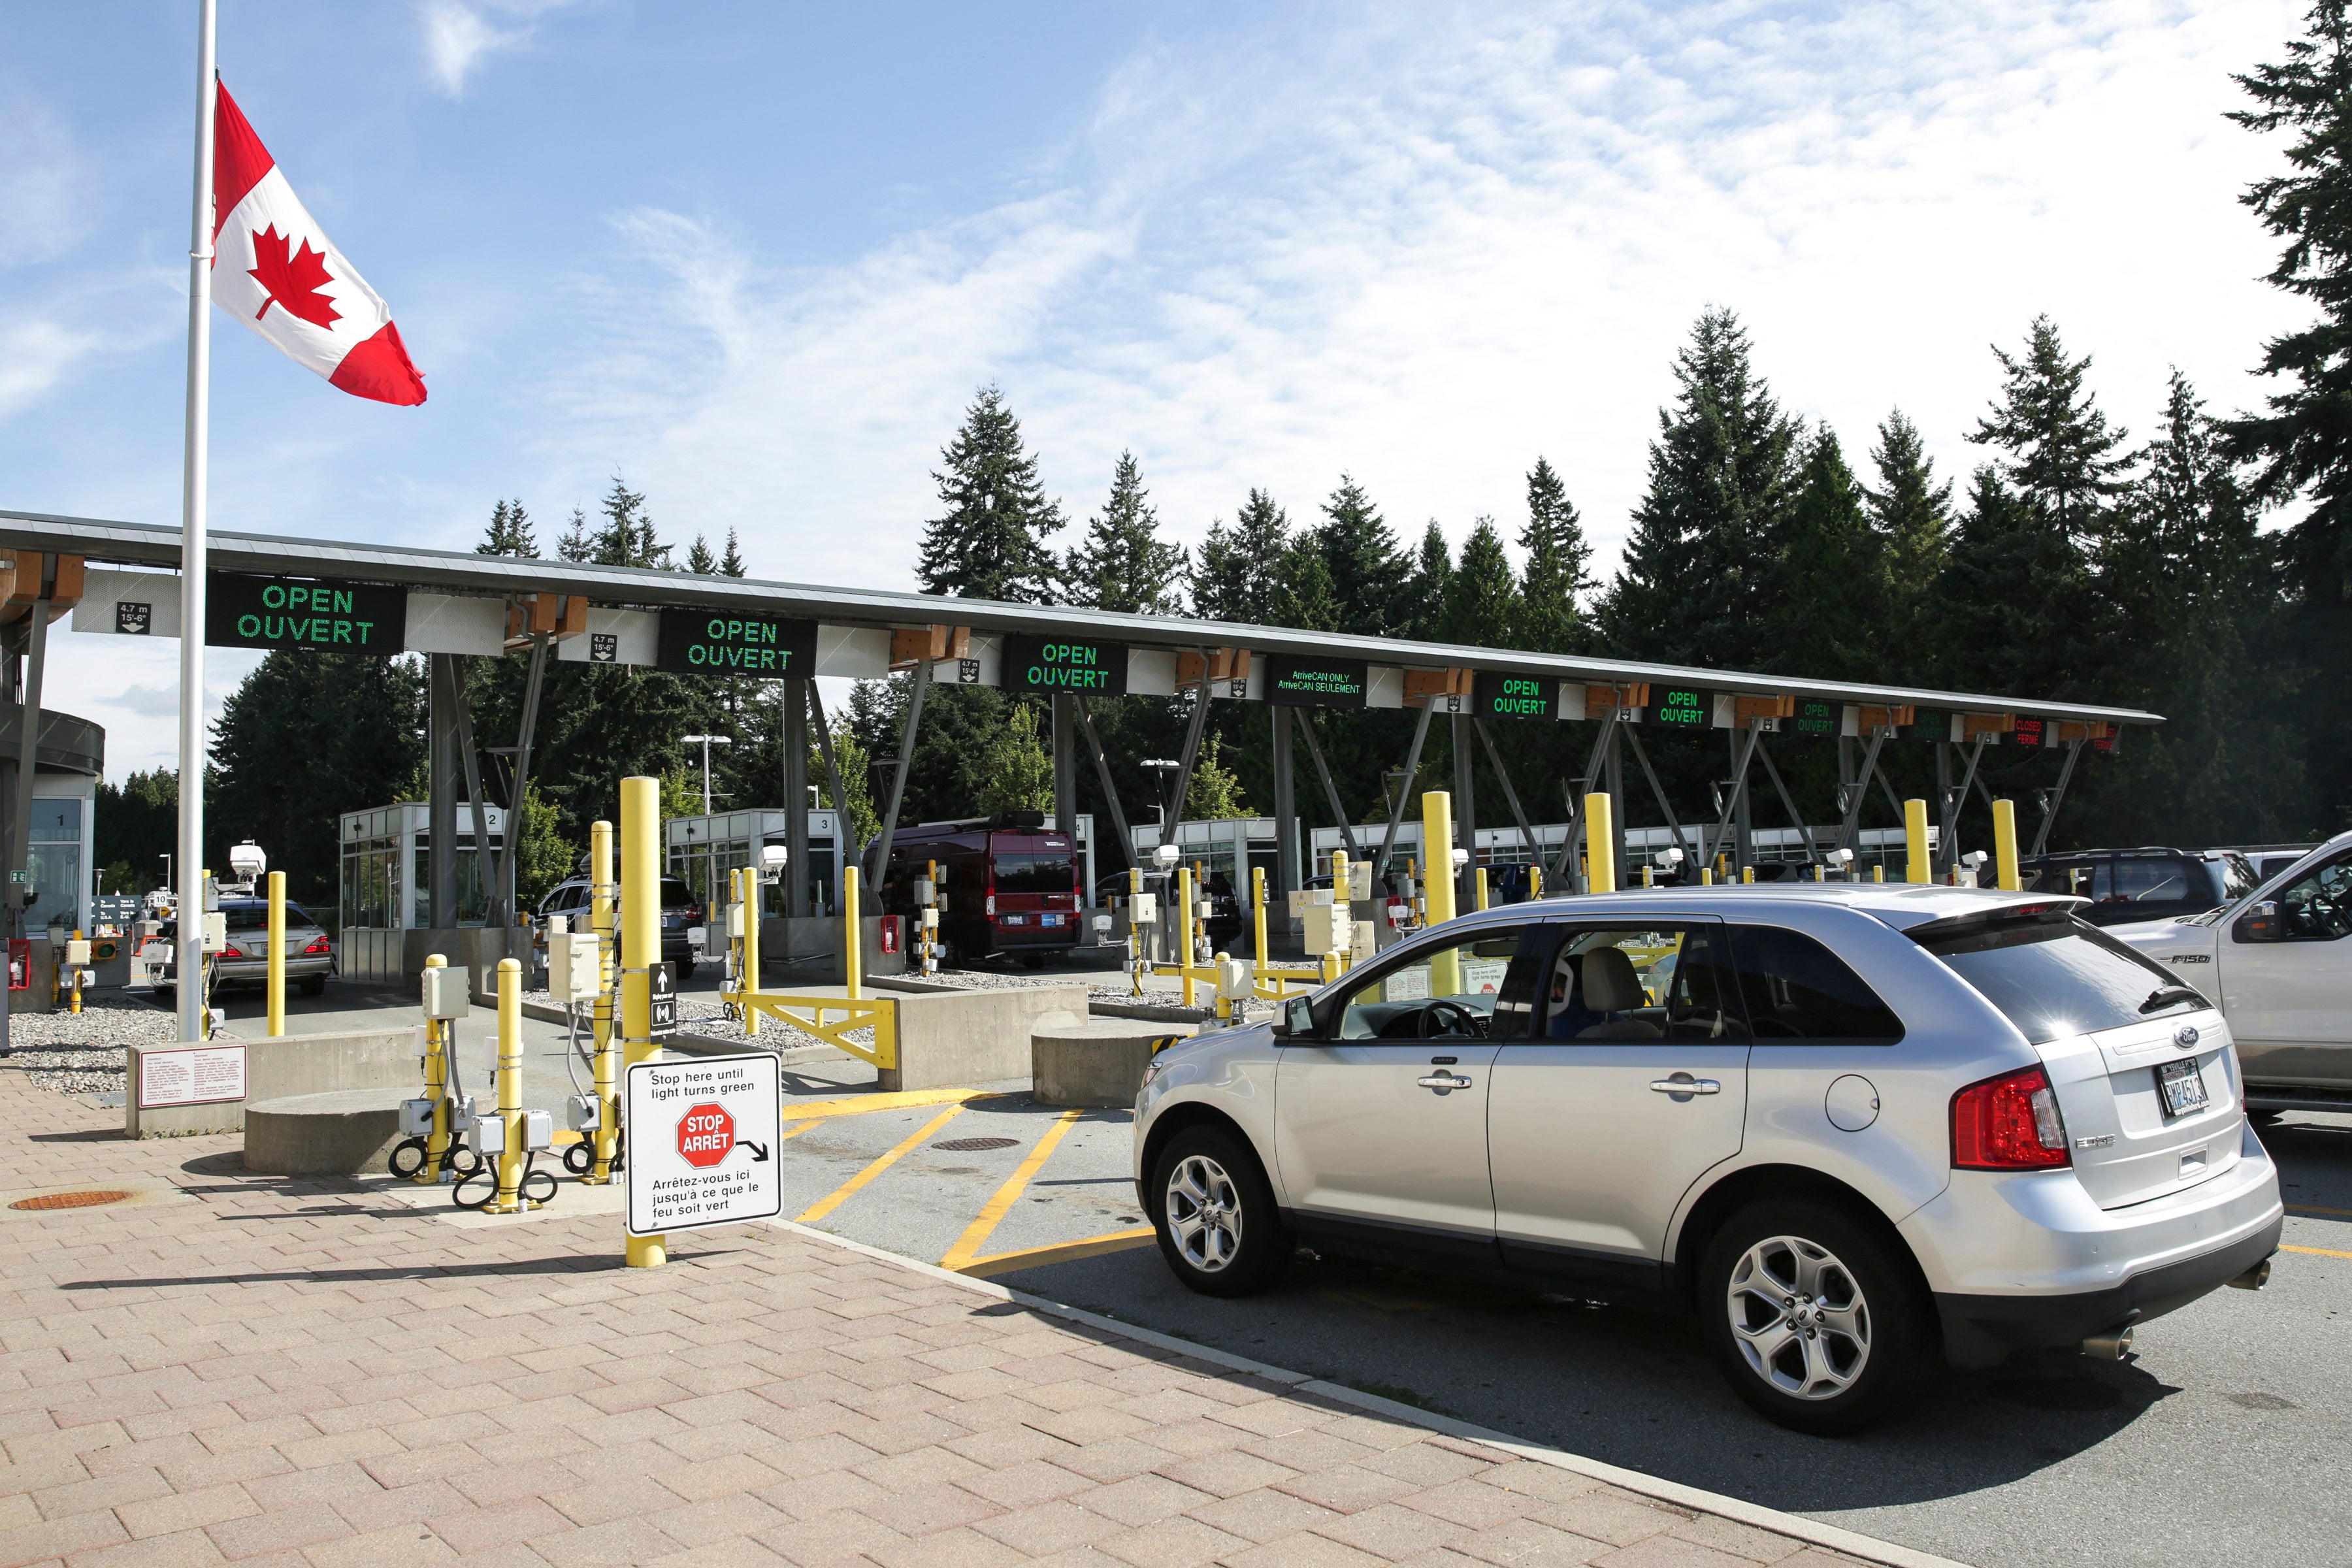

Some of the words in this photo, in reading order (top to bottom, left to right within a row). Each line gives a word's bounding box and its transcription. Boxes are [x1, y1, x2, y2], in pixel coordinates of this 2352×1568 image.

[263, 585, 353, 613] OPEN
[120, 604, 135, 613] 4.7
[121, 613, 146, 622] 15'-6"
[238, 614, 374, 645] OUVERT
[708, 619, 777, 644] OPEN
[688, 644, 792, 670] OUVERT
[1042, 644, 1096, 665] OPEN
[1028, 666, 1109, 689] OUVERT
[1292, 670, 1328, 681] ArriveCAN
[1329, 673, 1350, 683] ONLY
[1278, 679, 1314, 691] ArriveCAN
[1315, 682, 1360, 694] SEULEMENT
[1503, 679, 1539, 696] OPEN
[1494, 697, 1547, 715] OUVERT
[1668, 692, 1697, 706] OPEN
[1660, 708, 1704, 723] OUVERT
[1805, 704, 1829, 717] OPEN
[1798, 719, 1834, 732] OUVERT
[2016, 720, 2042, 732] CLOSED
[57, 814, 64, 826] 1
[489, 814, 496, 825] 2
[821, 819, 828, 829] 3
[2182, 1028, 2196, 1042] Ford
[651, 1075, 679, 1086] Stop
[685, 1073, 712, 1082] here
[717, 1068, 743, 1079] until
[651, 1088, 679, 1101] light
[684, 1086, 715, 1096] turns
[721, 1083, 754, 1096] green
[687, 1114, 725, 1132] STOP
[683, 1130, 729, 1152] ARRÊT
[2075, 1134, 2116, 1149] EDGE
[653, 1173, 731, 1190] Arrêtez-vous
[736, 1169, 750, 1180] ici
[653, 1189, 697, 1207] jusqu'à
[702, 1189, 716, 1198] ce
[721, 1186, 743, 1198] que
[749, 1183, 759, 1192] le
[653, 1208, 672, 1218] feu
[678, 1203, 700, 1215] soit
[706, 1200, 728, 1211] vert
